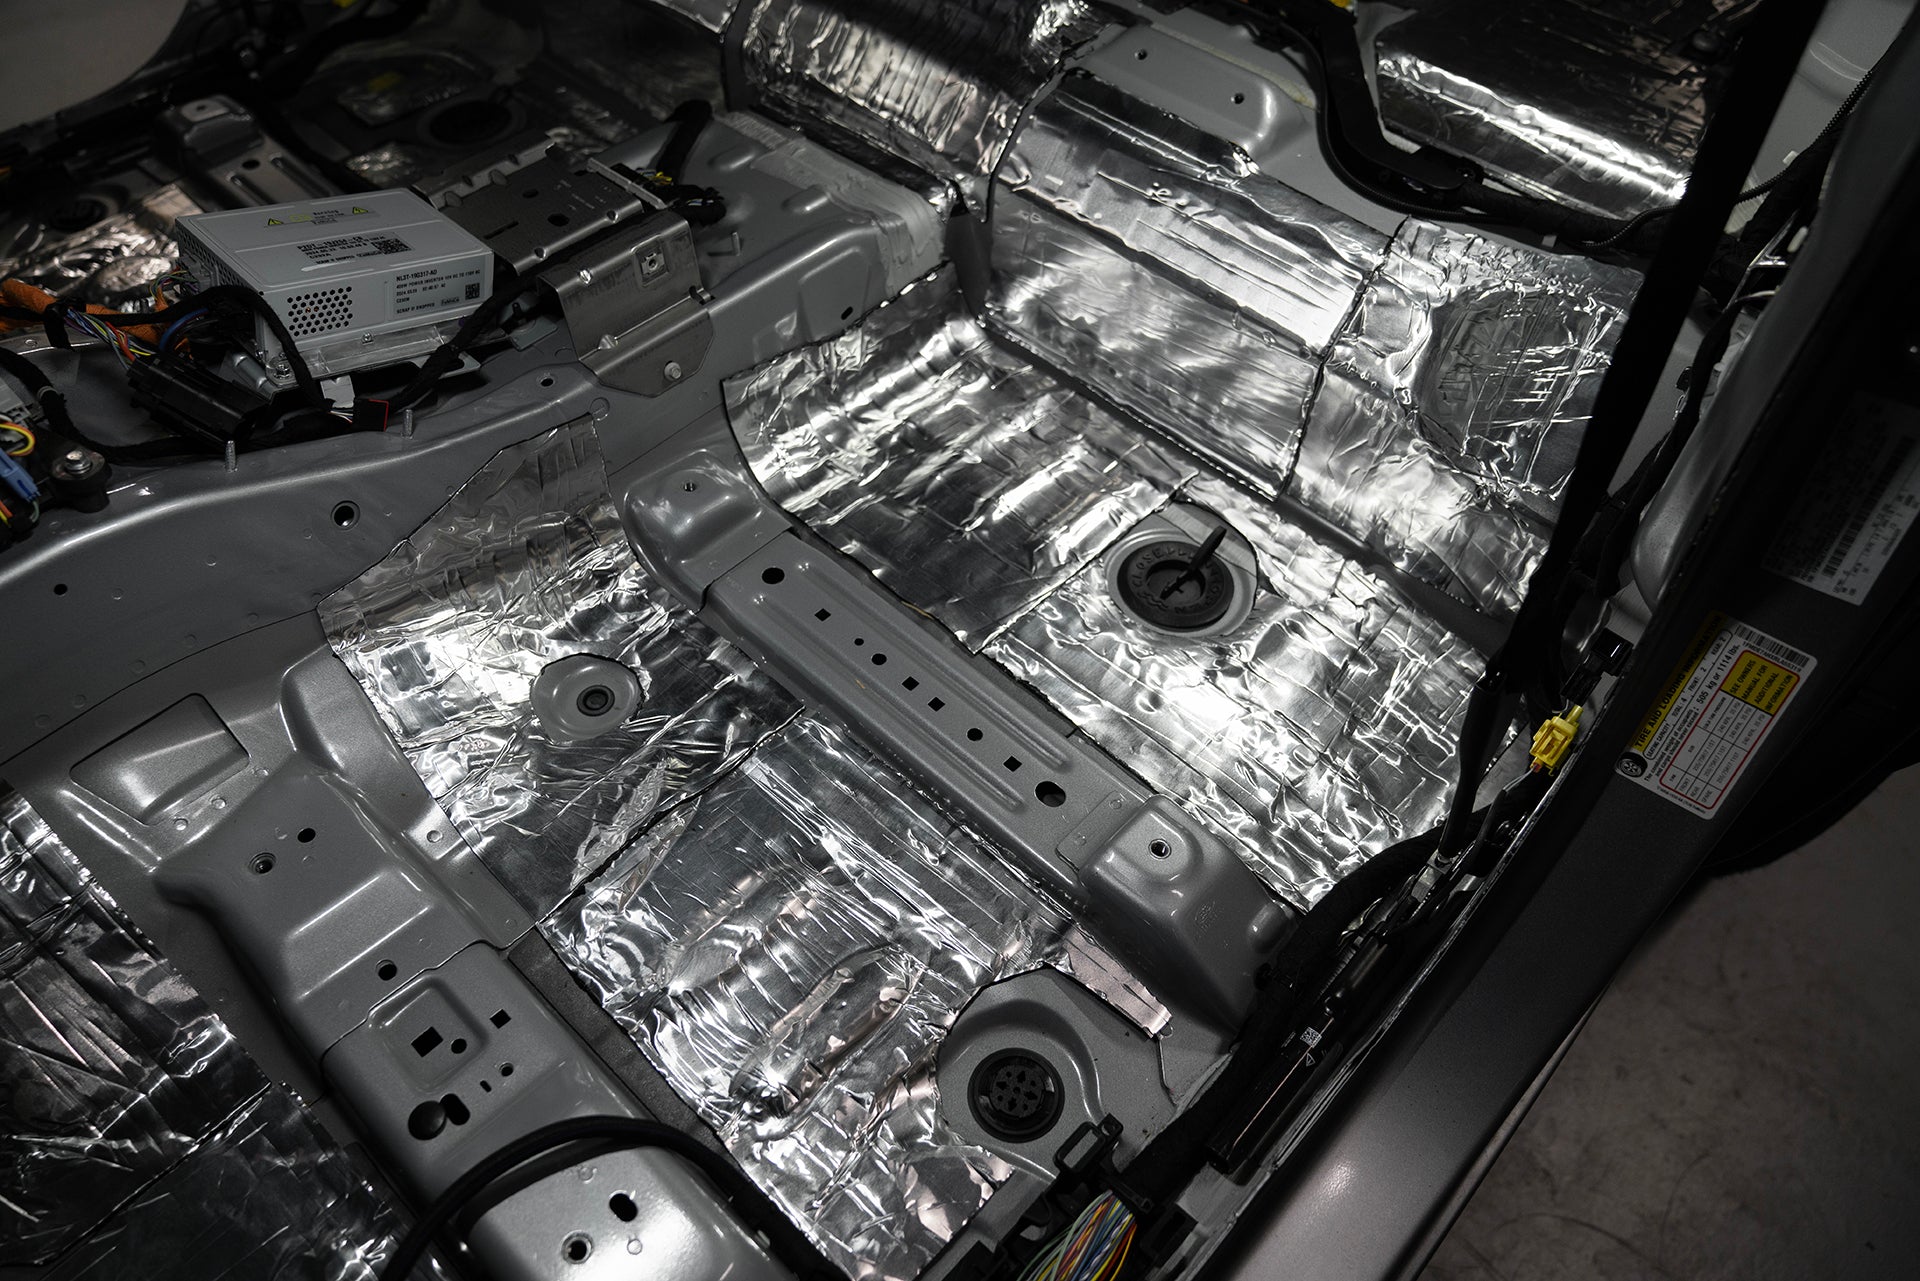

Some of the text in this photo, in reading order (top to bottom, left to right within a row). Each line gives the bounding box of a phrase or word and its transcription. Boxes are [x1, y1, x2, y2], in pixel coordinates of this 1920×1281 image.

[1634, 614, 1722, 748] TIRE AND LOADING INFORMATION
[1695, 689, 1709, 704] 505
[1704, 679, 1717, 690] kg
[1716, 654, 1732, 672] 1114
[1726, 642, 1739, 656] lbs.
[1729, 658, 1756, 694] SEE OWNERS
[1740, 663, 1768, 700] MANUAL FOR
[1753, 670, 1779, 704] ADDITIONAL
[1764, 673, 1793, 711] INFORMATION
[1645, 740, 1659, 757] SEATING
[1655, 722, 1670, 741] CAPACITY
[1649, 751, 1666, 773] combined
[1662, 736, 1676, 752] weight
[1675, 708, 1694, 732] occupants
[1659, 754, 1672, 768] cargo
[1667, 739, 1680, 755] should
[1677, 727, 1689, 740] never
